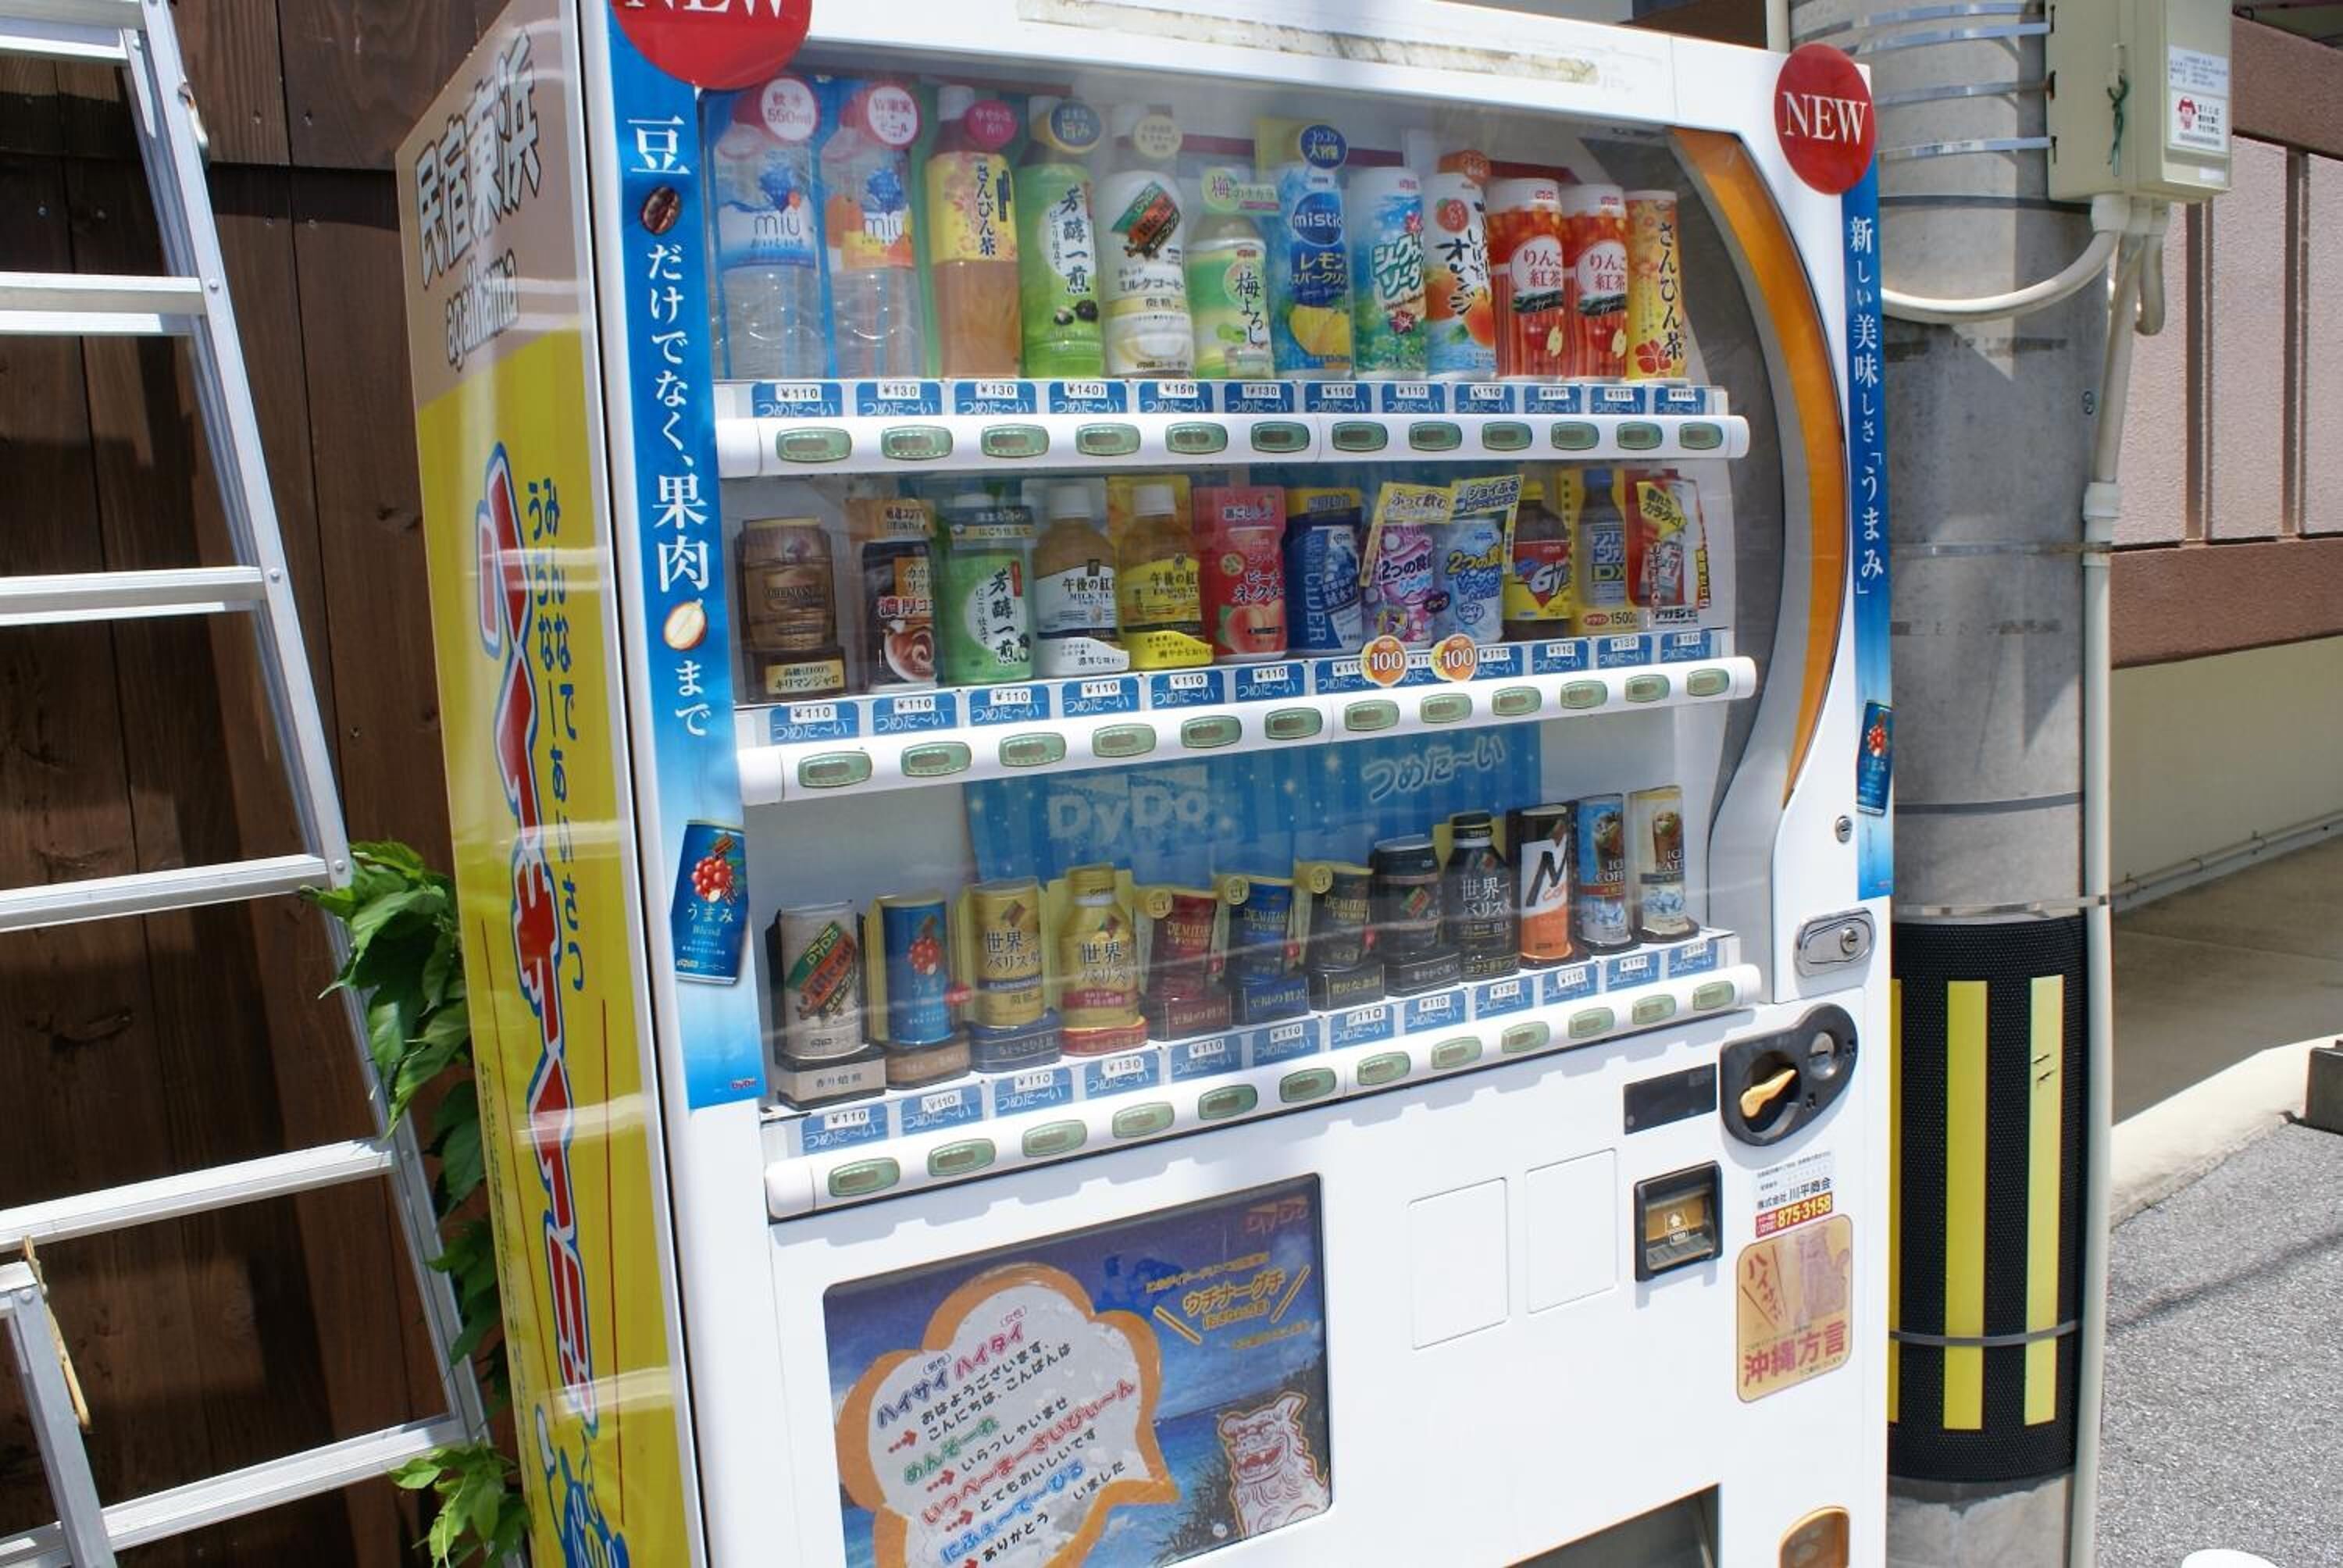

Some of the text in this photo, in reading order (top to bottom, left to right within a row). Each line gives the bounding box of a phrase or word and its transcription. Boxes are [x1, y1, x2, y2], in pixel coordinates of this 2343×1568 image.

[1783, 91, 1868, 145] NEW
[1060, 184, 1090, 294] 芳醇一煎
[781, 388, 818, 400] ¥110
[883, 386, 917, 397] ¥130
[981, 384, 1015, 397] ¥130
[1325, 386, 1353, 397] ¥110
[1399, 386, 1425, 397] ¥110
[1849, 216, 1884, 595] 新しい美味しさ「うまみ」
[627, 116, 691, 175] 豆
[674, 659, 711, 737] まで
[544, 477, 576, 742] みんなで
[989, 568, 1018, 665] 芳醇一煎
[1549, 646, 1573, 655] ¥110
[1371, 651, 1403, 671] 100
[1445, 649, 1475, 668] 100
[1256, 668, 1286, 679] ¥110
[1174, 675, 1204, 686] ¥110
[1085, 682, 1118, 693] ¥110
[898, 698, 932, 709] ¥110
[996, 692, 1029, 703] ¥110
[793, 707, 831, 719] ¥110
[1361, 736, 1505, 801] つめた〜い
[1047, 783, 1209, 842] DyDo
[687, 901, 734, 924] うまみ
[1422, 999, 1446, 1009] ¥110
[1272, 1027, 1300, 1039] ¥110
[1193, 1041, 1222, 1053] ¥110
[1108, 1060, 1141, 1072] ¥130
[1018, 1074, 1050, 1086] ¥110
[927, 1095, 956, 1108] ¥110
[830, 1112, 866, 1124] ¥110
[1778, 1194, 1831, 1228] 875-3158
[1182, 1267, 1286, 1317] ウチナーグチ
[1744, 1320, 1847, 1388] 沖縄方言
[877, 1320, 1023, 1428] ハイサイ ハイタイ
[961, 1396, 1069, 1472] いらっしゃいませ
[904, 1416, 1000, 1485] めんそーれ
[980, 1427, 1097, 1513] とてもおいしいです
